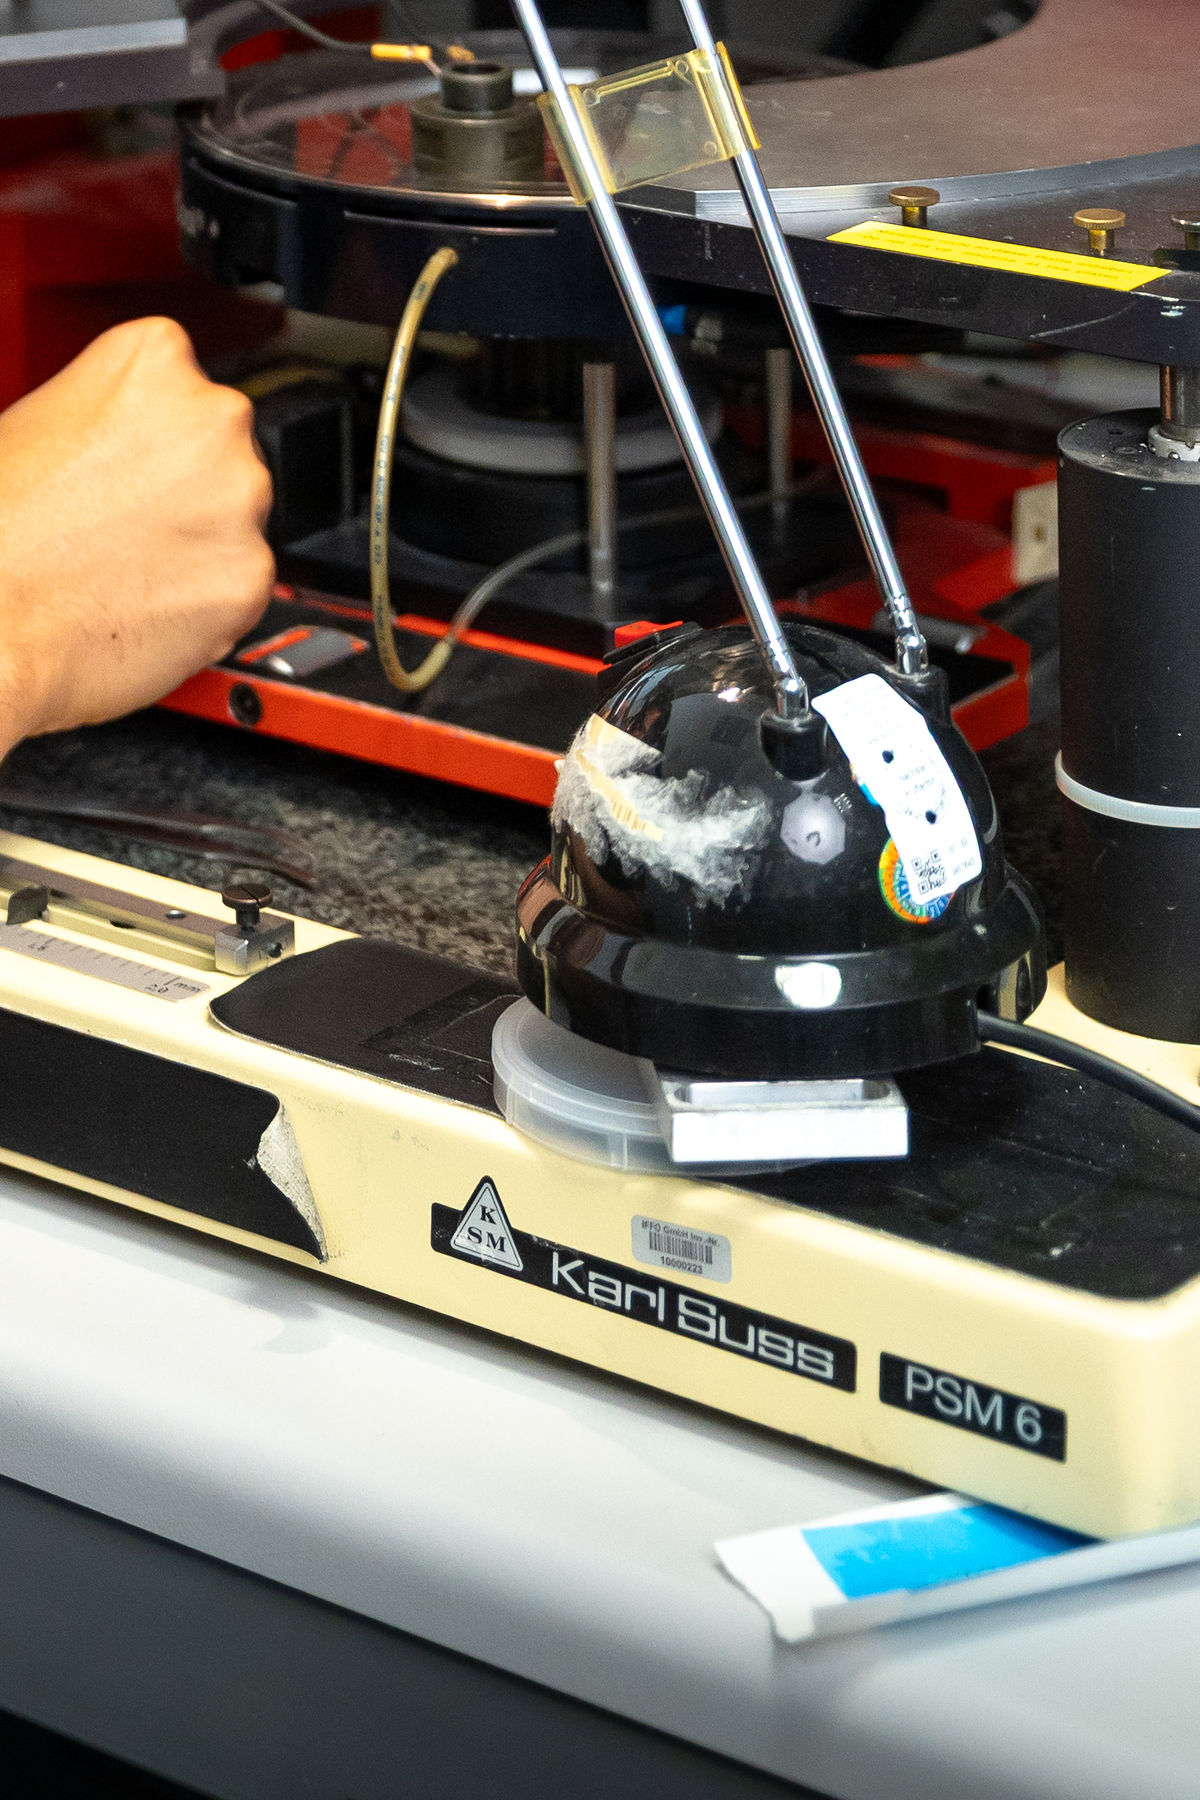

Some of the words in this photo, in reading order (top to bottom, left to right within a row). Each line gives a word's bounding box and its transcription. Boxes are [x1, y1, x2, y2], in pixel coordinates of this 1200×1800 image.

[479, 1204, 497, 1225] K
[663, 1224, 689, 1239] GmbH
[552, 1251, 665, 1322] Karl
[677, 1293, 835, 1380] Suss
[906, 1364, 1004, 1432] PSM
[1015, 1404, 1043, 1444] 6
